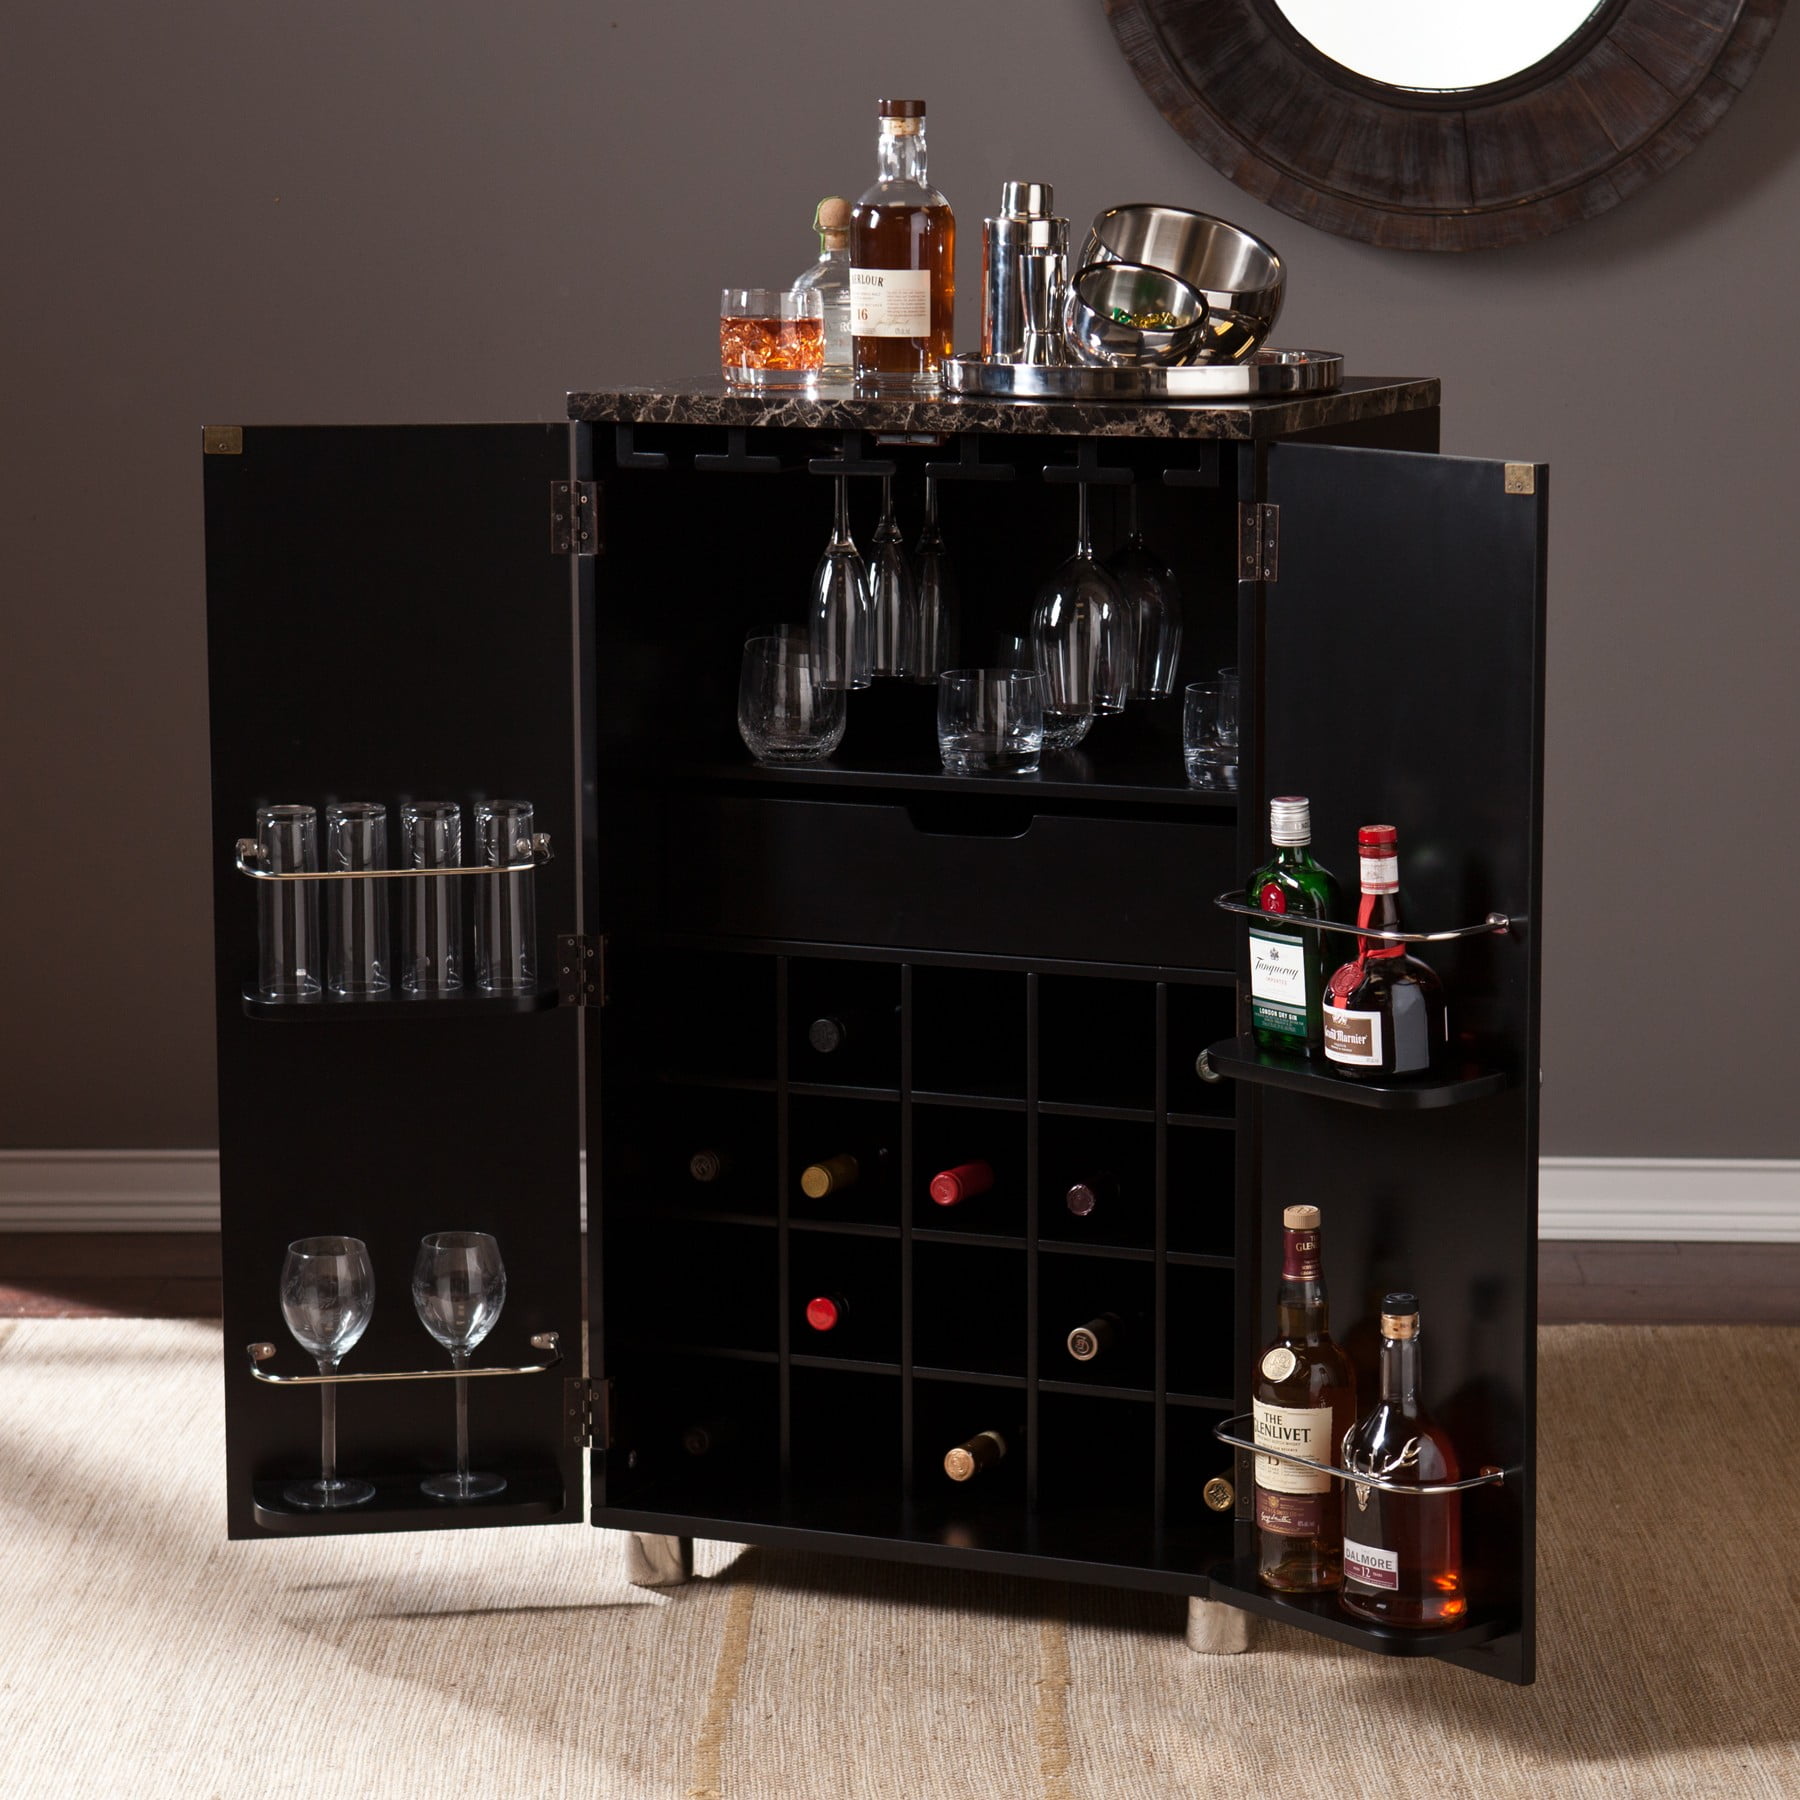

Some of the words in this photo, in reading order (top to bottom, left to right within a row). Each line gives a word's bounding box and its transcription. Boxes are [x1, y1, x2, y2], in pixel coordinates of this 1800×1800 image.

[858, 308, 868, 320] 16
[1256, 957, 1299, 980] Tanqueray
[1259, 1007, 1277, 1017] LONDON
[1279, 1011, 1288, 1019] DRY
[1264, 1412, 1282, 1425] THE
[1345, 1548, 1392, 1570] DALMORE
[1361, 1567, 1371, 1578] 12
